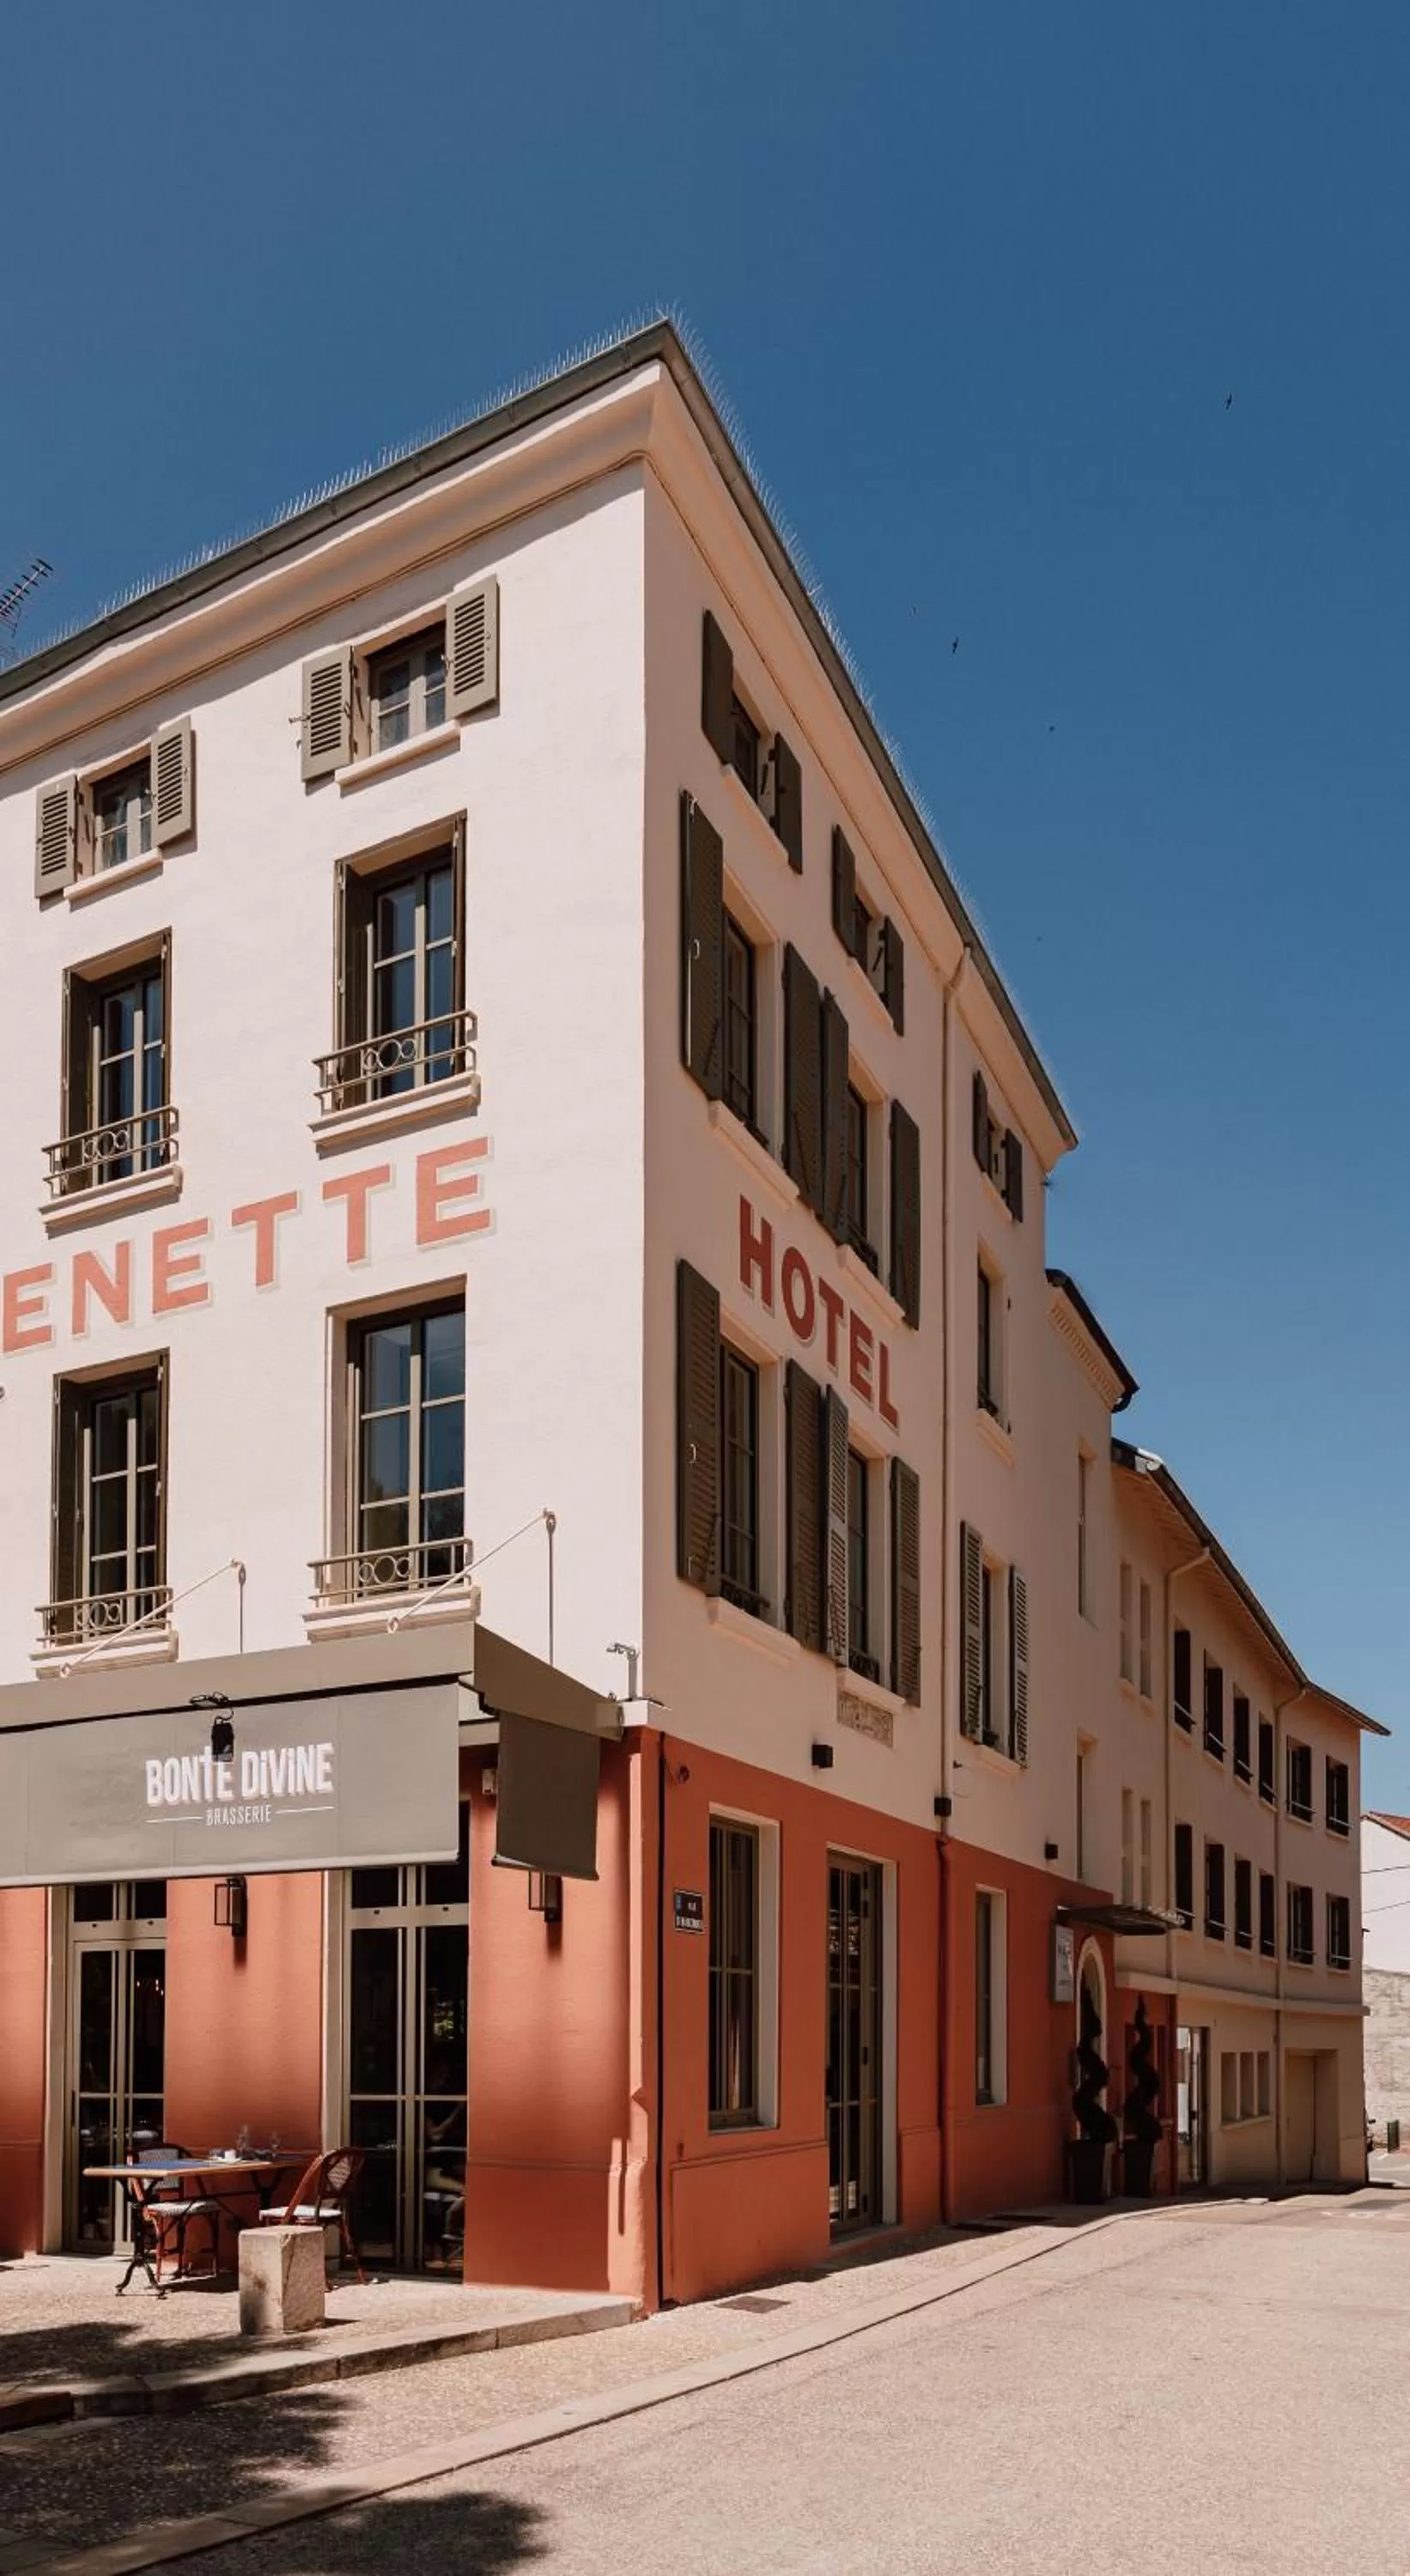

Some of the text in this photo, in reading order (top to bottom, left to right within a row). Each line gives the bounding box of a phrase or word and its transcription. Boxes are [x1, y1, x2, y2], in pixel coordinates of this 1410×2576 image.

[3, 1135, 492, 1352] ENETTE
[739, 1194, 899, 1430] HOTEL
[206, 1804, 271, 1826] BRASSERIE
